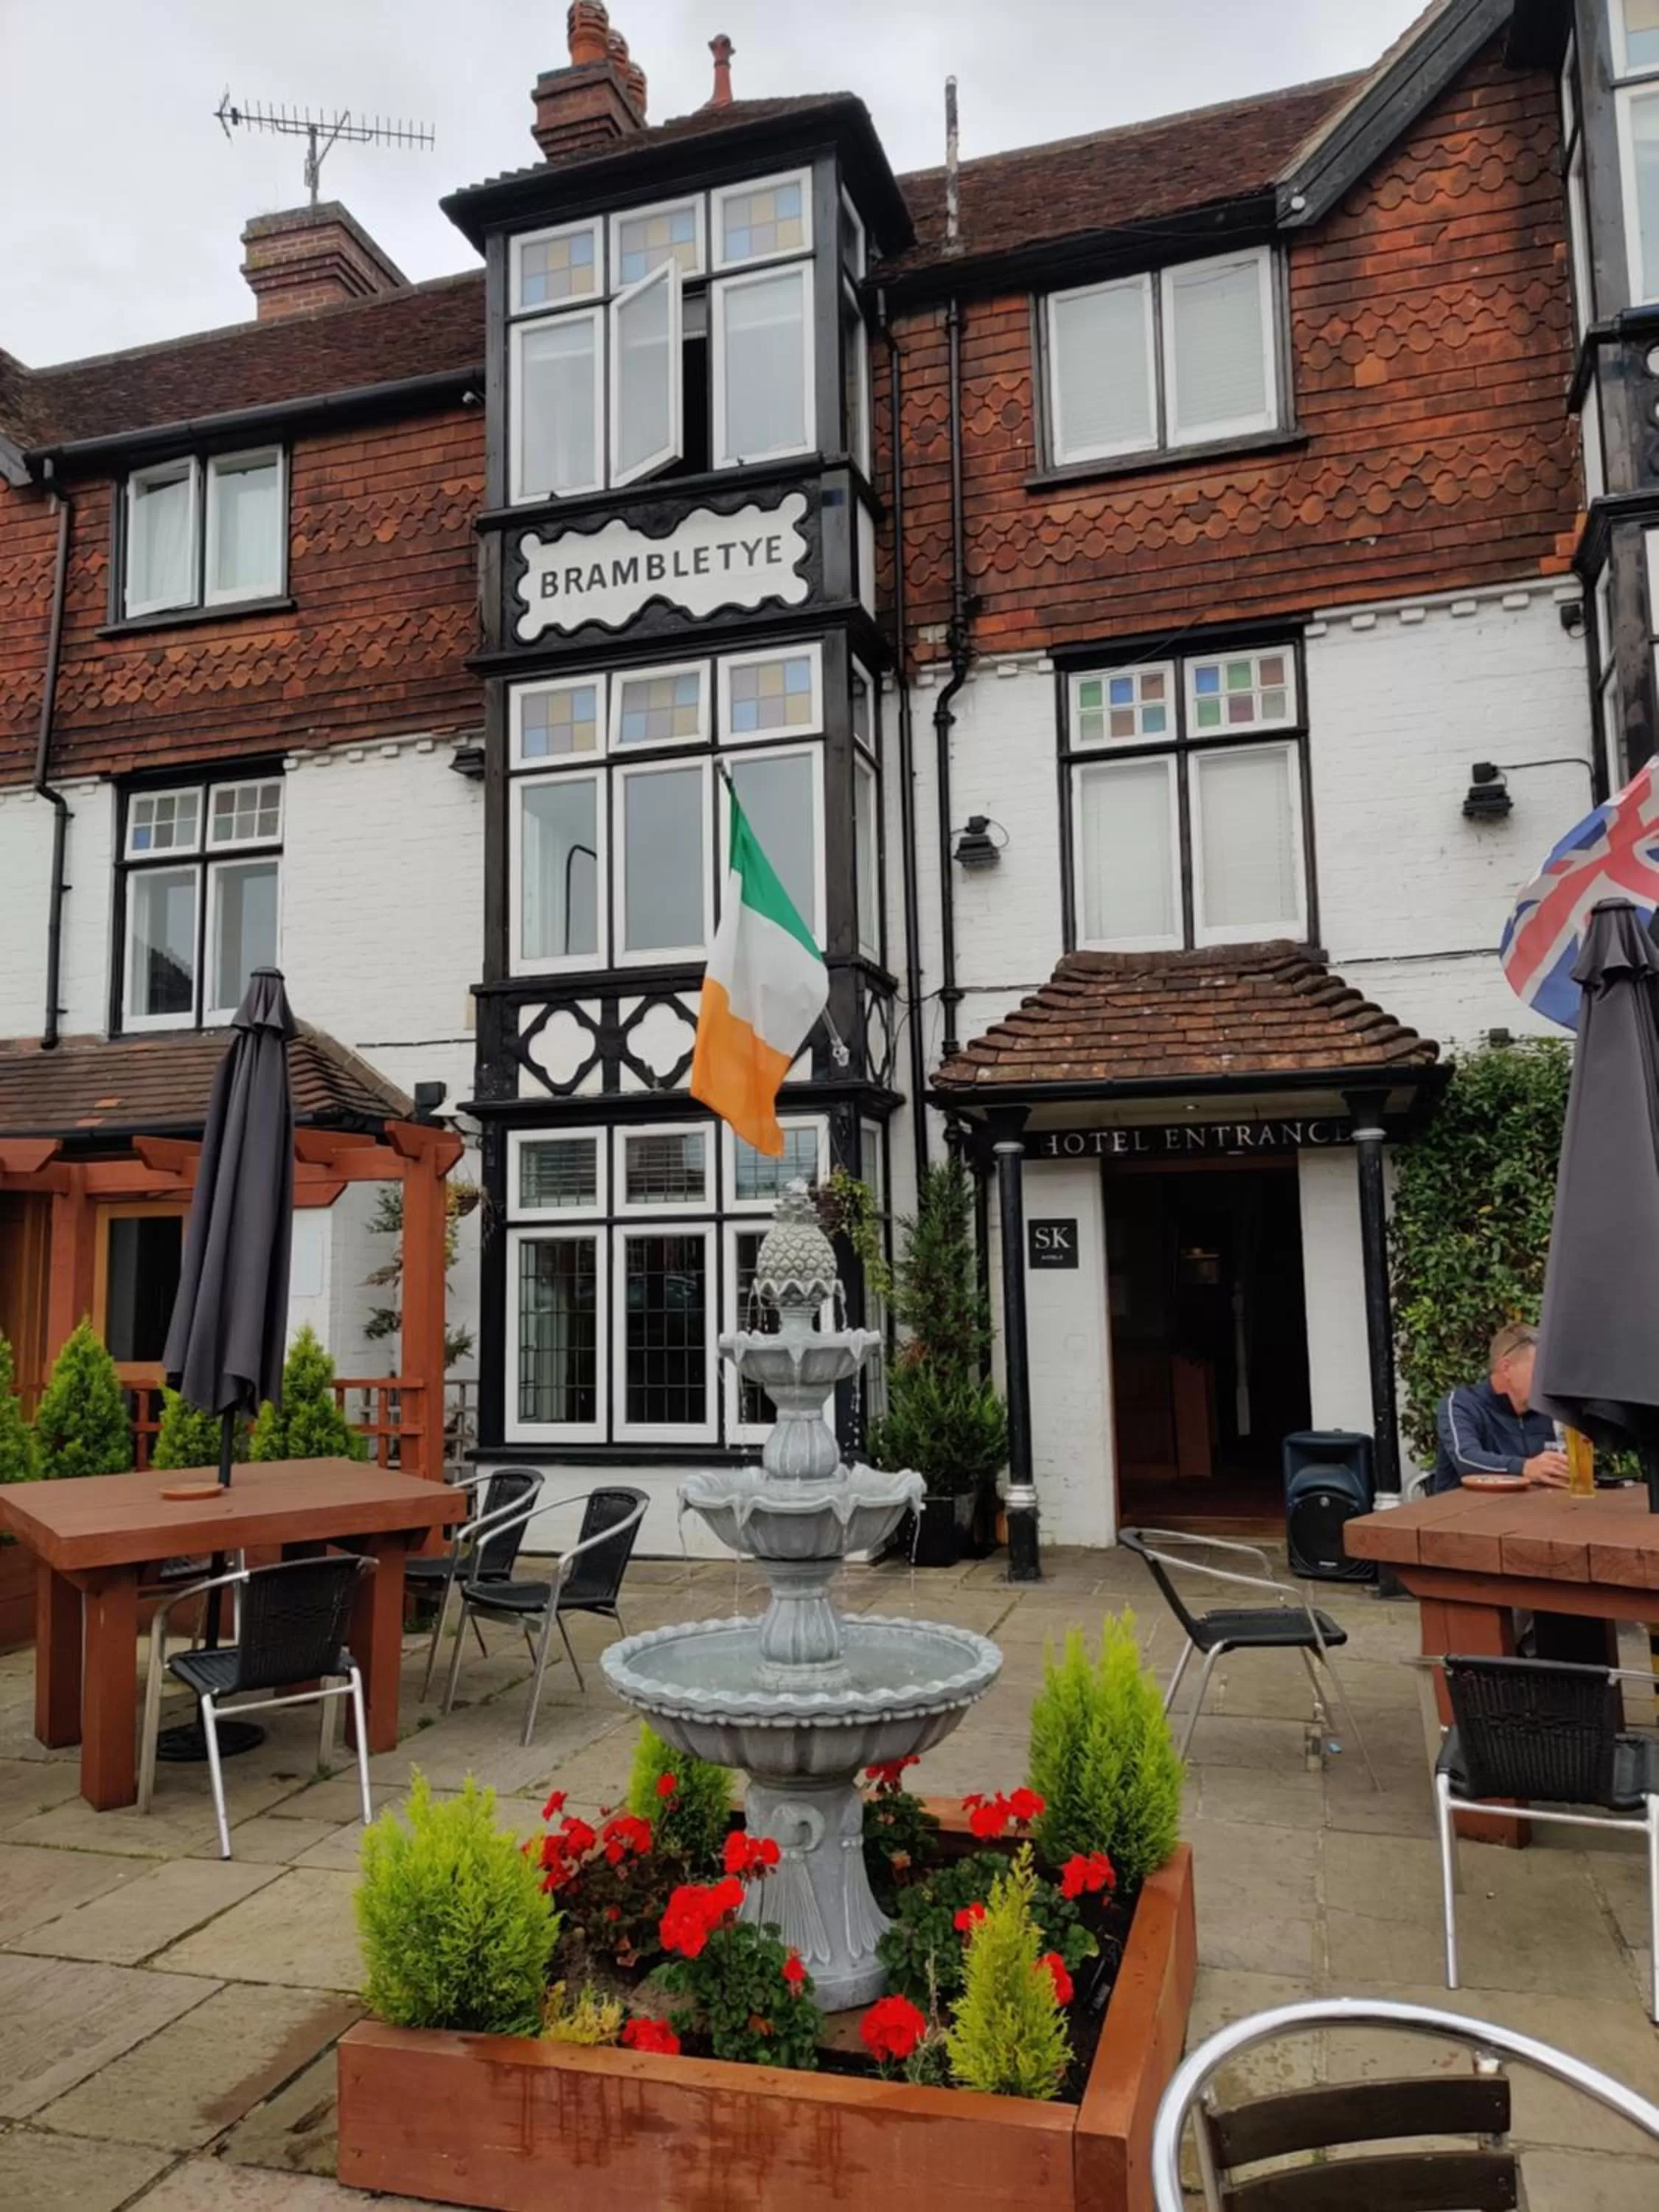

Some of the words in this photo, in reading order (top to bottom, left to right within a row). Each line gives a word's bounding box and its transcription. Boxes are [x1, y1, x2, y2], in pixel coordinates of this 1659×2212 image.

[540, 535, 783, 599] BRAMBLETYE
[1040, 1131, 1150, 1155] HOTEL
[1165, 1121, 1351, 1150] ENTRANCE
[1034, 1226, 1071, 1249] SK
